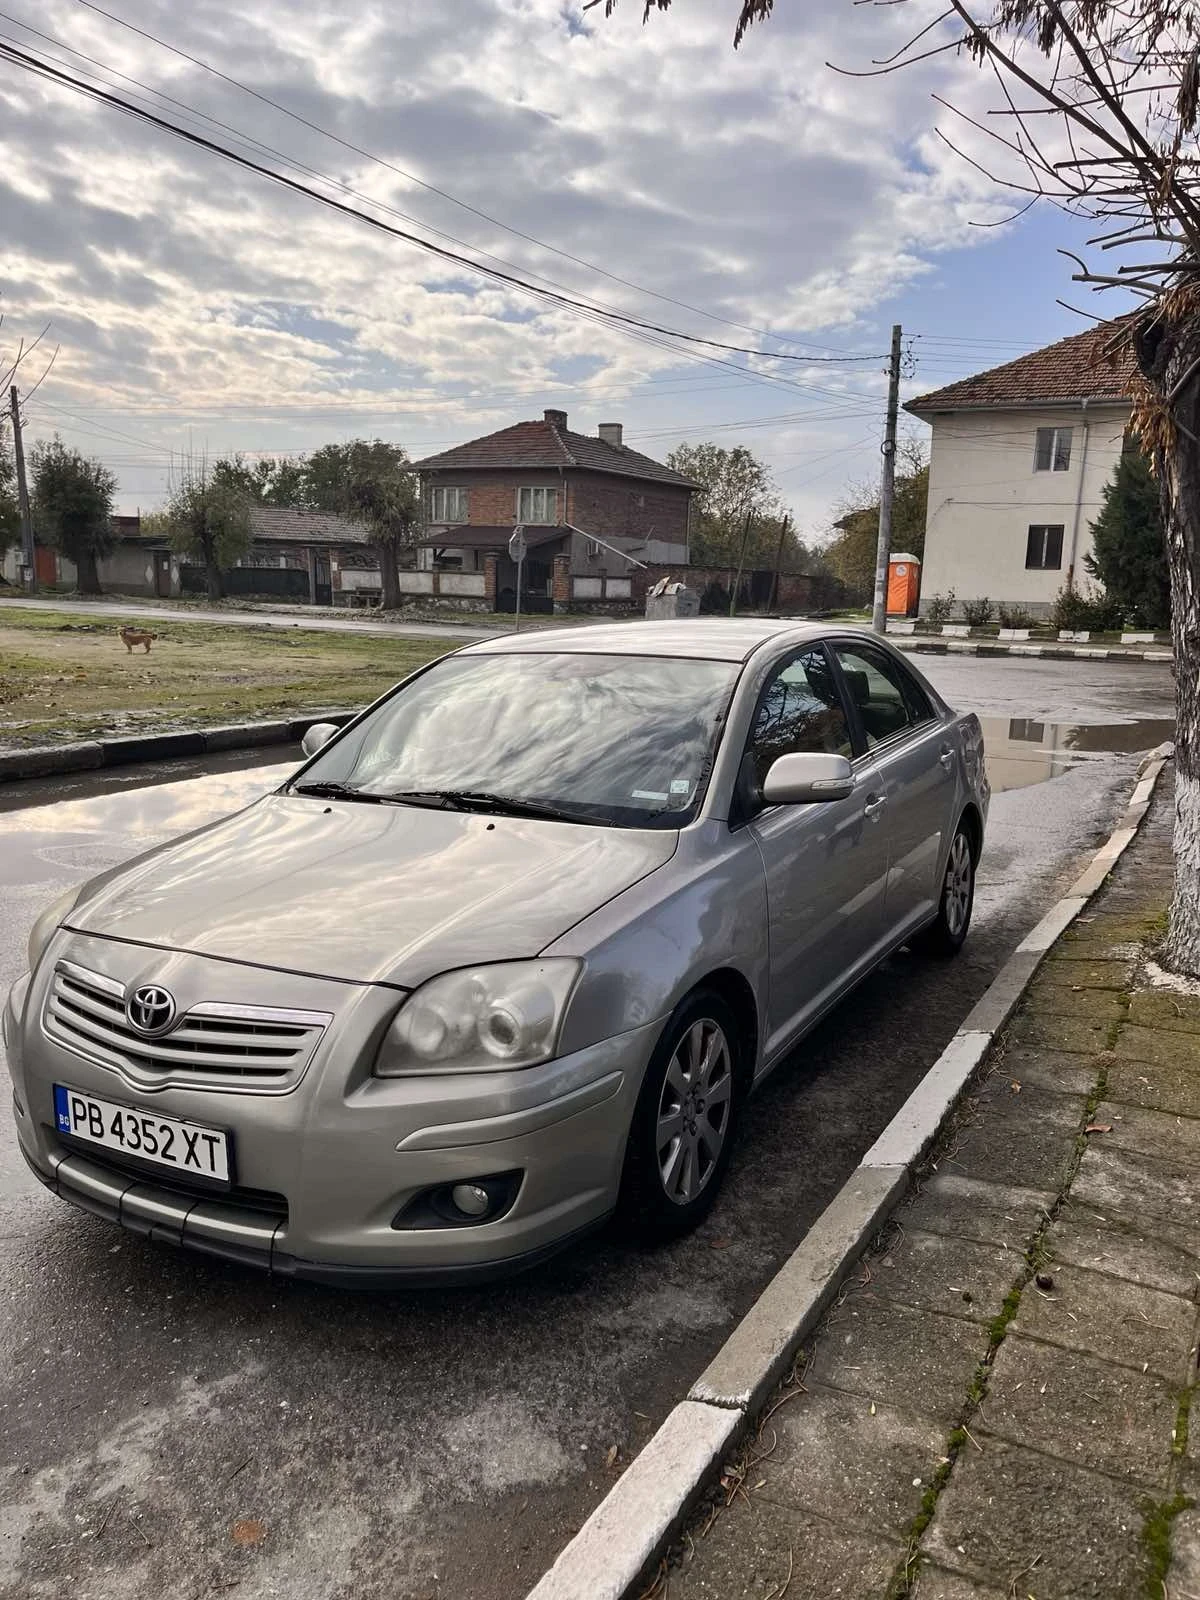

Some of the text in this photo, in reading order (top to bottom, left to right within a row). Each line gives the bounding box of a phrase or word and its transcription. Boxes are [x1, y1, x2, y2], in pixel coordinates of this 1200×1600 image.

[59, 1114, 70, 1126] BG
[72, 1097, 220, 1172] PB 4352 XT
